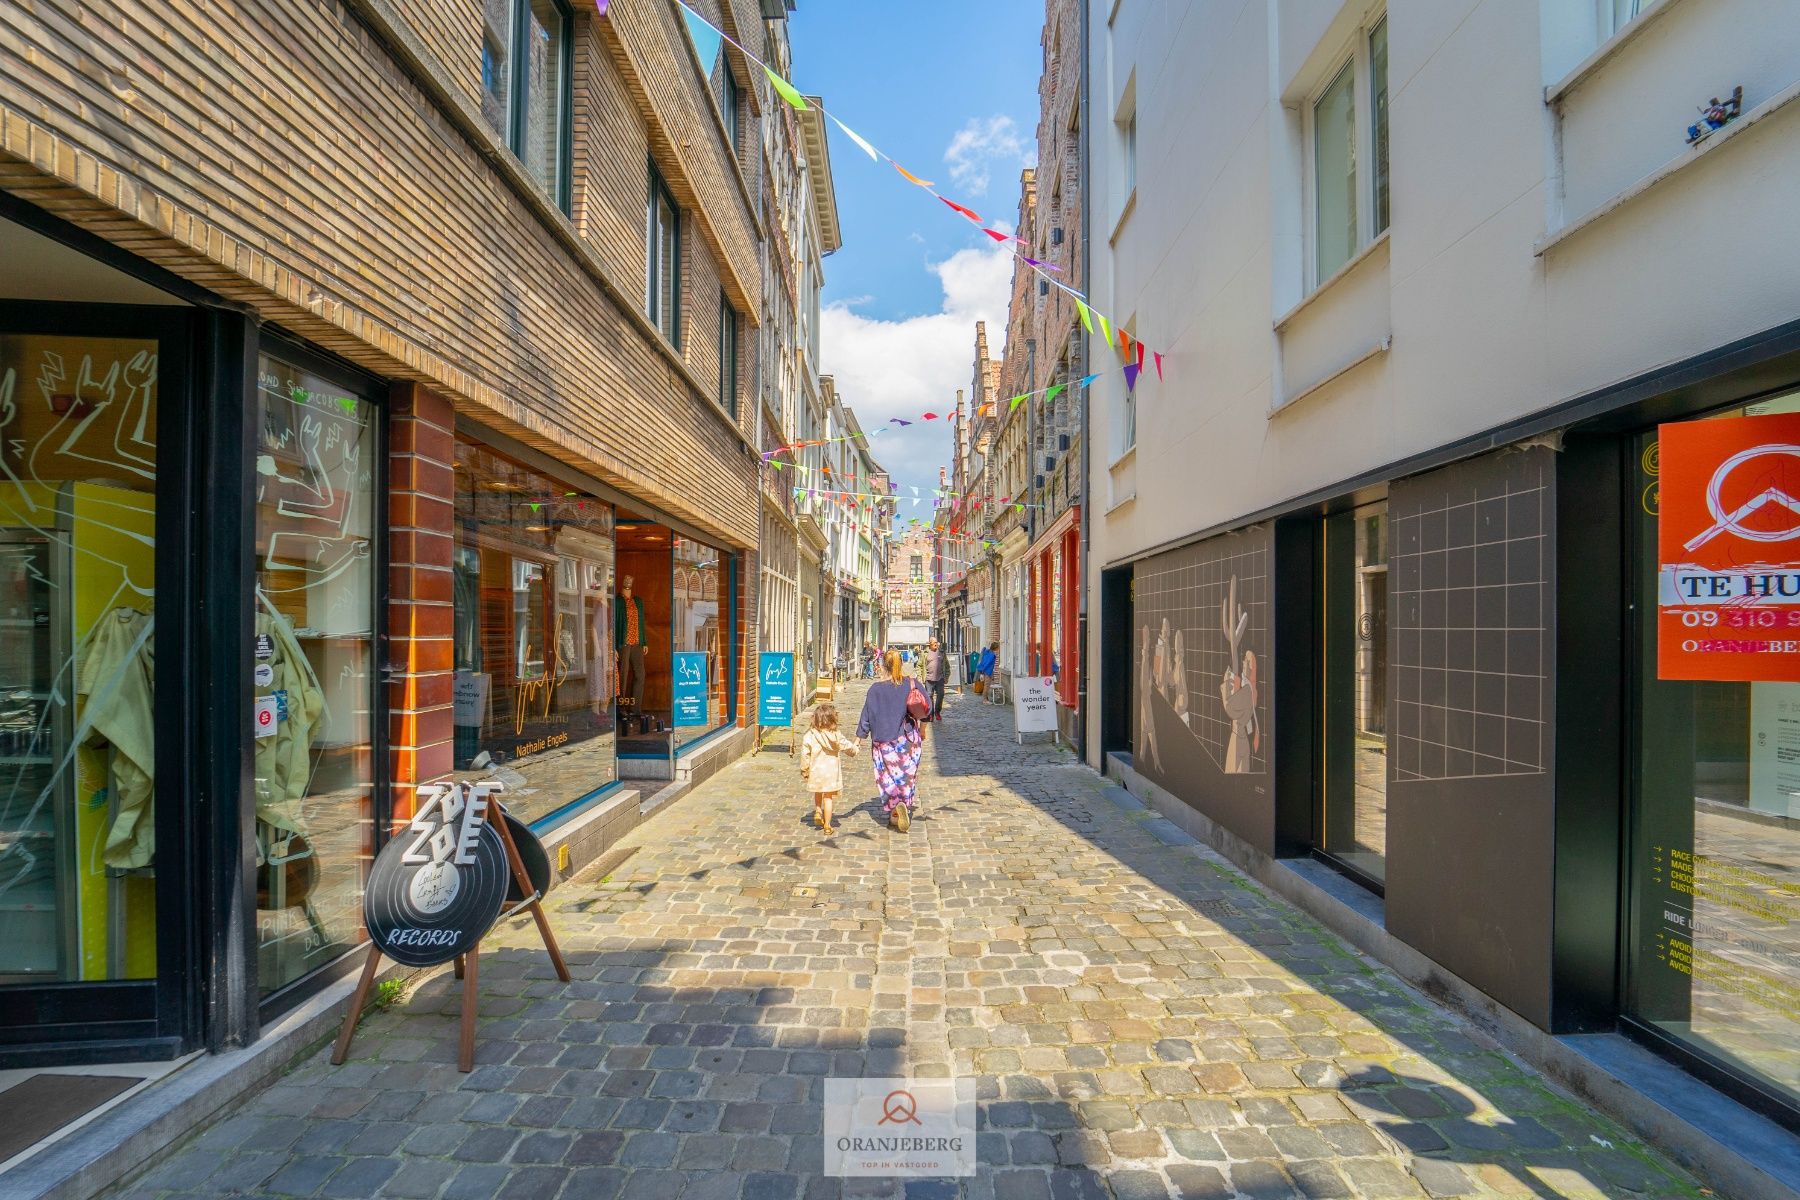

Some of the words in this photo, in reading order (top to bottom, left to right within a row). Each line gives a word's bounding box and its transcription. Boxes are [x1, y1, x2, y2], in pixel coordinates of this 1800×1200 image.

[1681, 576, 1732, 598] TE
[1743, 574, 1800, 597] HU
[1682, 610, 1719, 627] 09
[1029, 687, 1042, 695] the
[1021, 695, 1050, 703] wonder
[1026, 704, 1047, 713] years
[516, 738, 546, 758] Nathalie
[547, 731, 568, 749] Engels
[1671, 849, 1691, 862] RACE
[1664, 910, 1686, 926] RIDE
[261, 910, 297, 942] PUNK
[386, 928, 462, 946] RECORDS
[1669, 938, 1692, 953] AVOID
[1669, 949, 1692, 964] AVOID
[1669, 960, 1692, 975] AVOID
